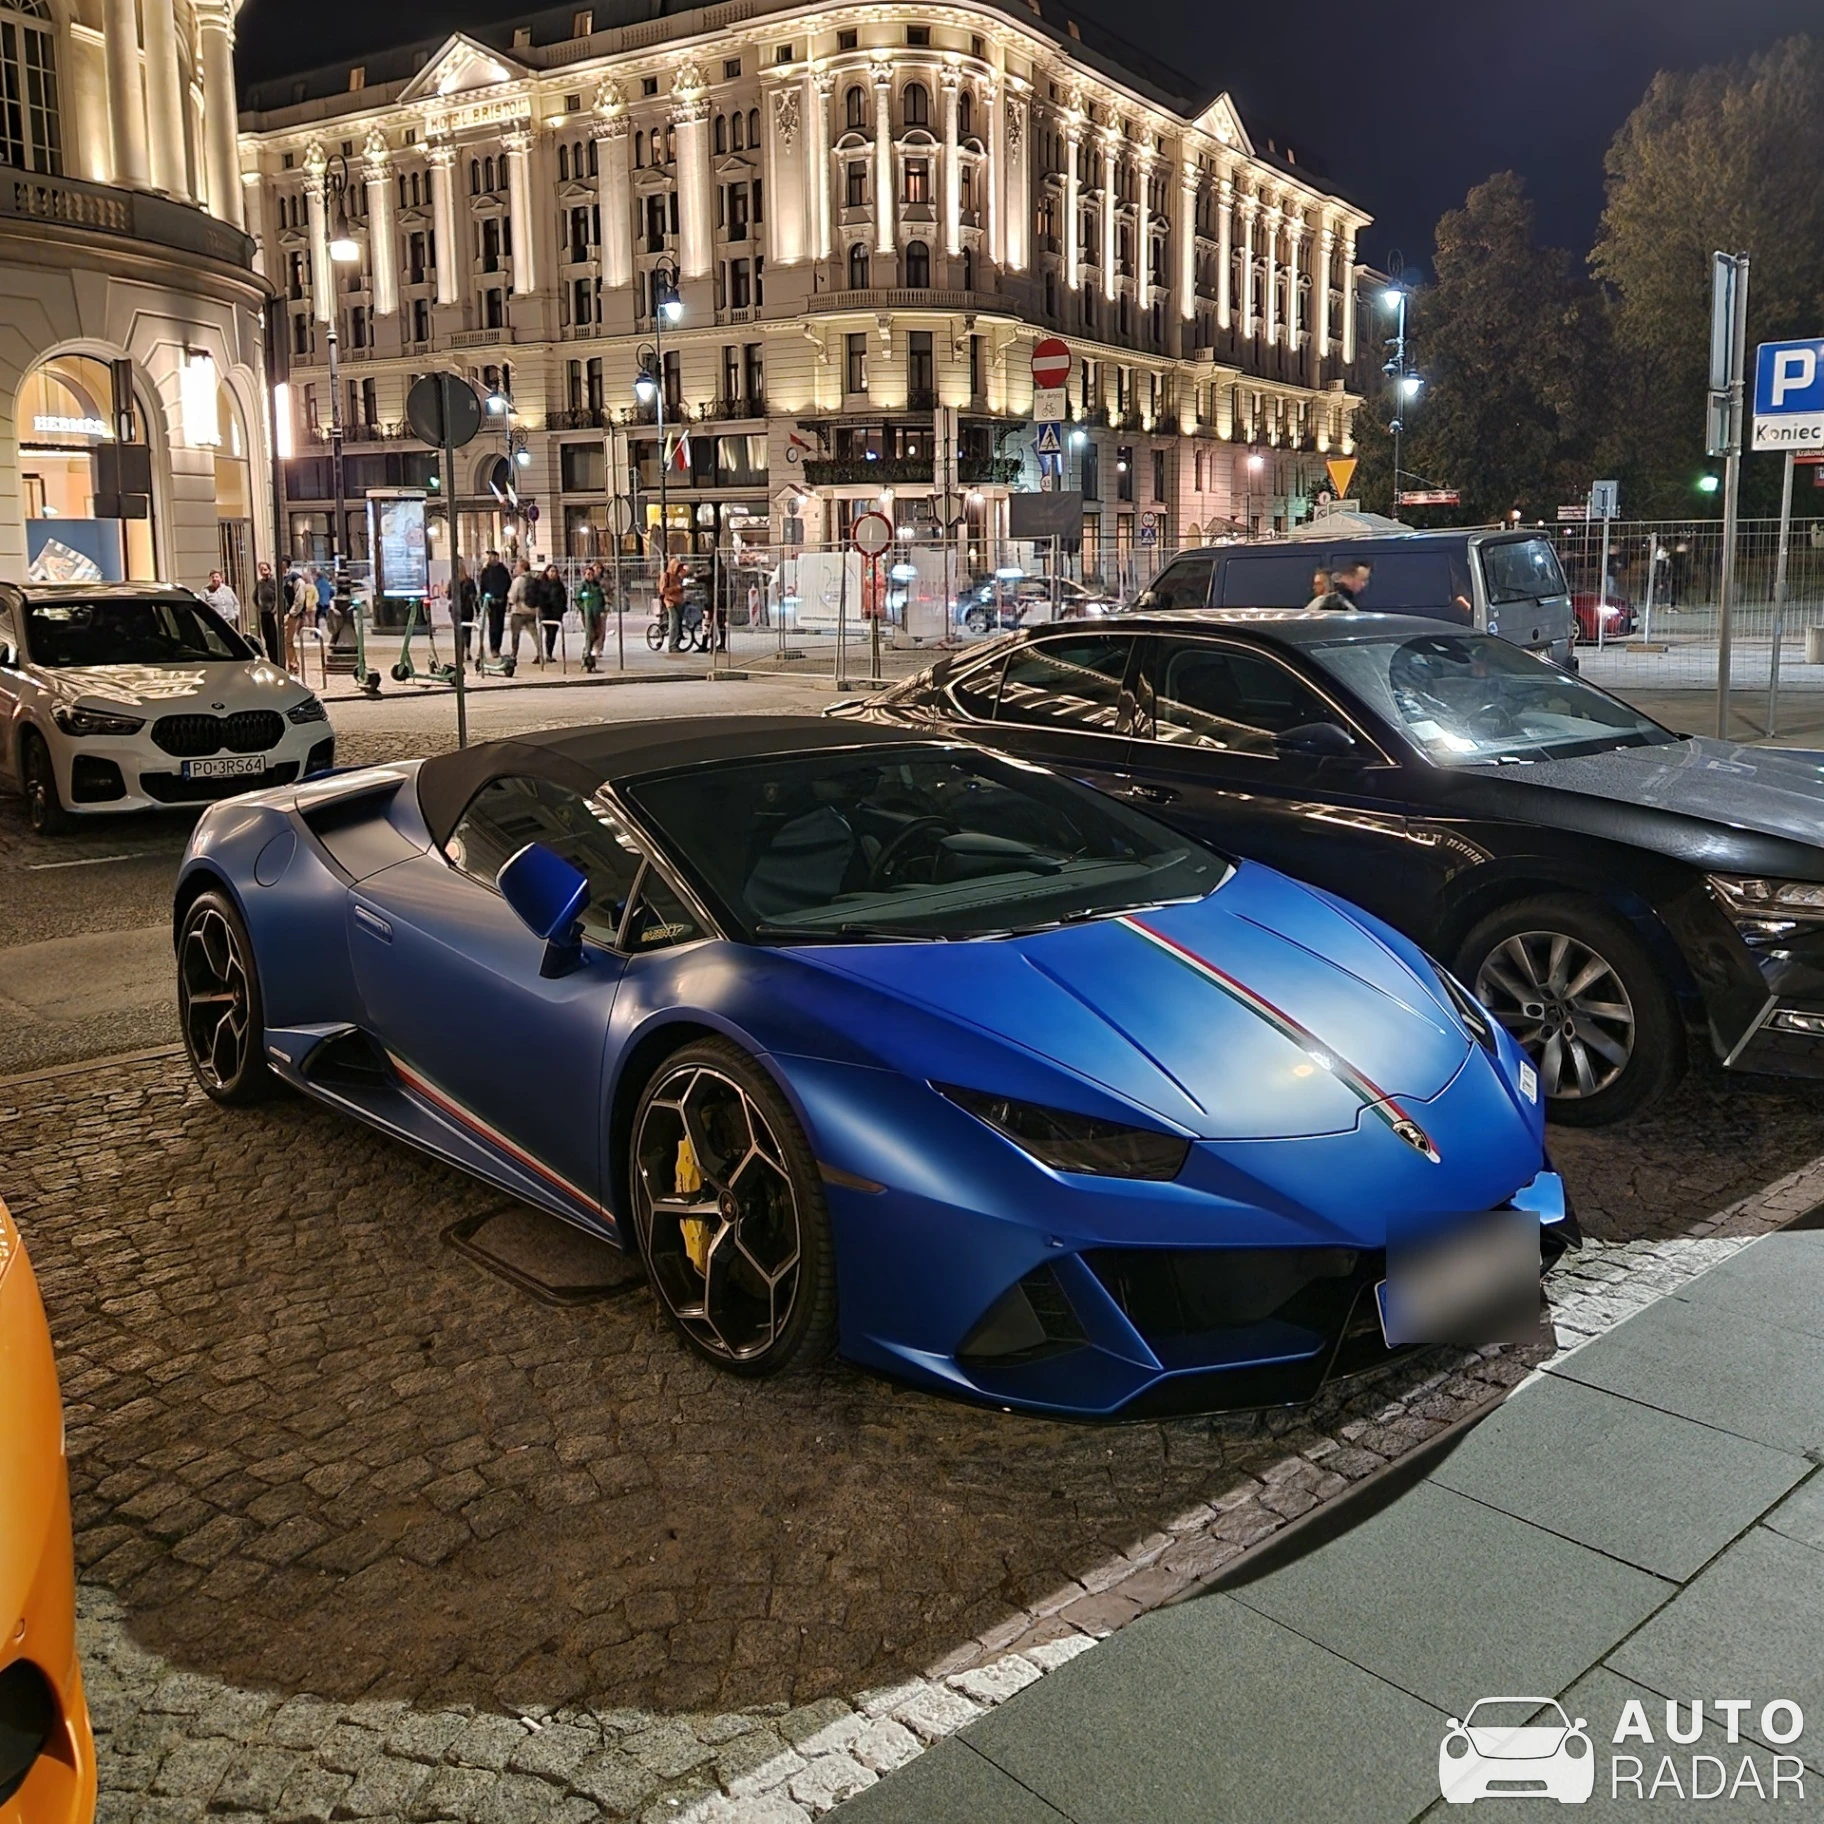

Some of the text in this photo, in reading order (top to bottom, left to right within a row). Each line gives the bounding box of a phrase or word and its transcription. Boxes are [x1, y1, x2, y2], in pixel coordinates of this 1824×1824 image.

[431, 99, 526, 131] HOTEL BRISTOL
[1771, 348, 1816, 407] P
[1756, 422, 1821, 441] Koniec
